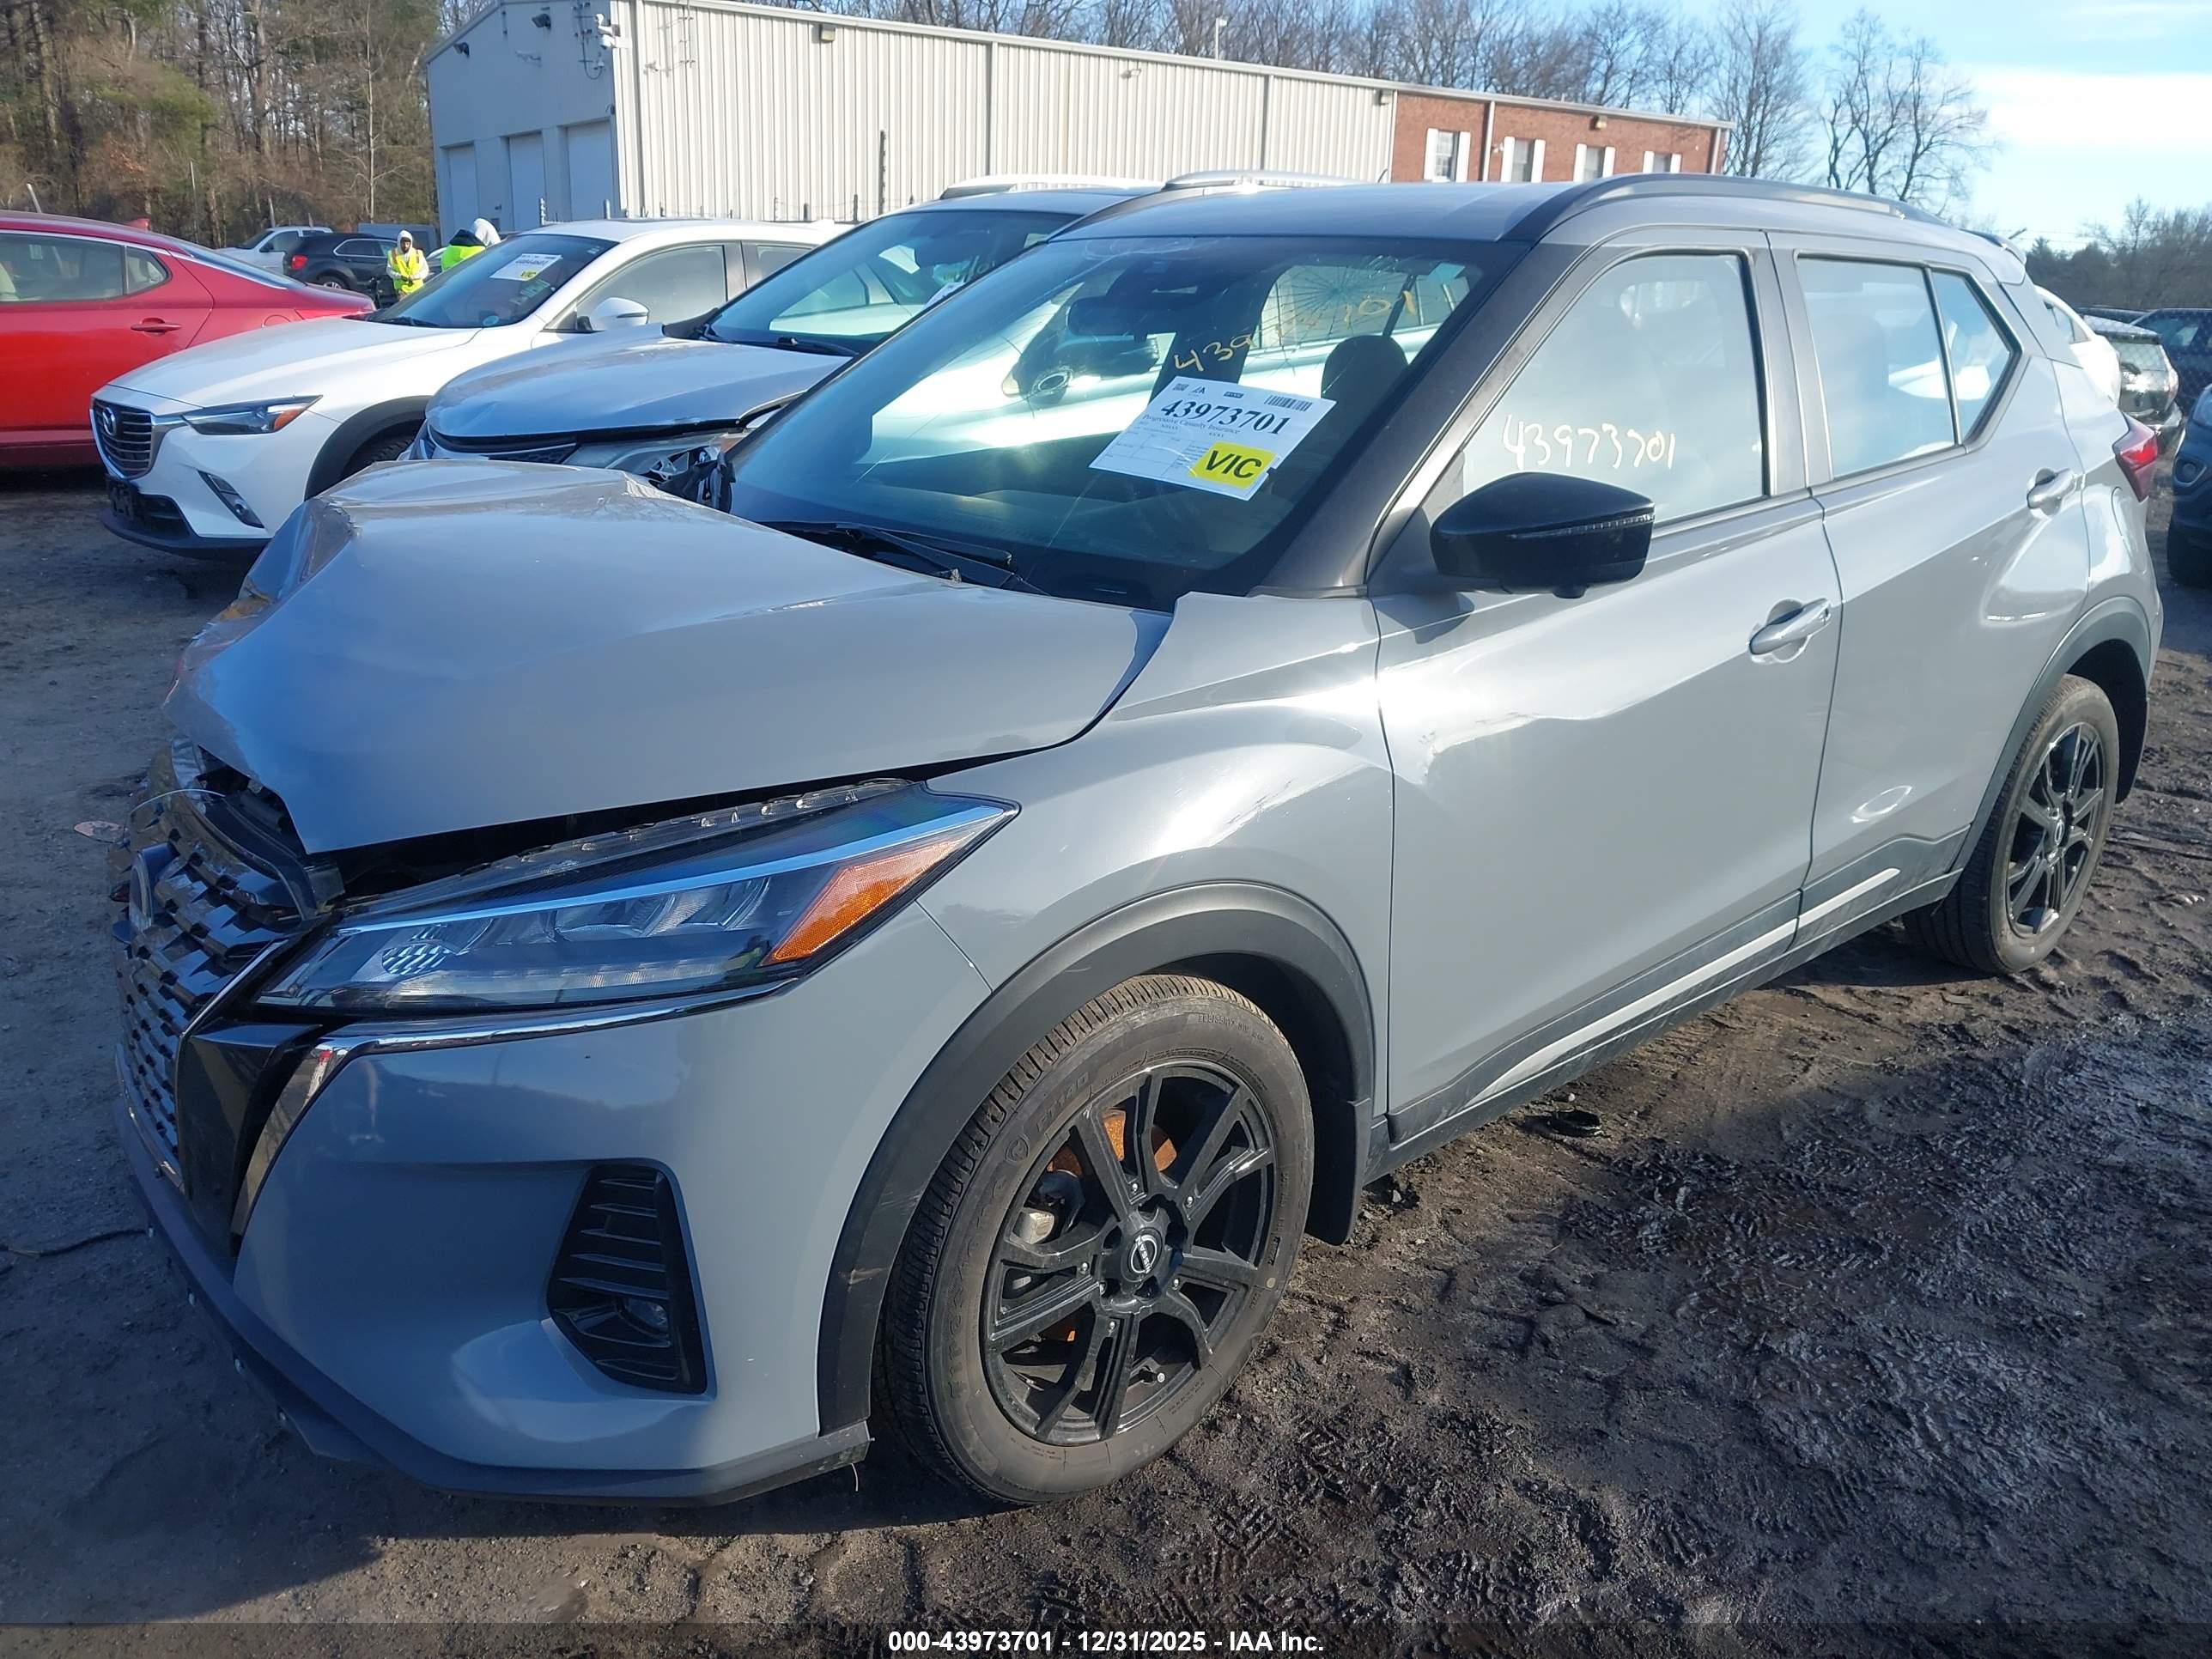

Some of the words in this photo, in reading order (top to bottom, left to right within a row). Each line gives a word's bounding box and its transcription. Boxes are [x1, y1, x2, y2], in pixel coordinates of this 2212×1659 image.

[1161, 399, 1291, 434] 43973701
[1502, 414, 1675, 470] 43973701
[1206, 450, 1262, 479] VIC
[1135, 1235, 1152, 1274] NISSAN
